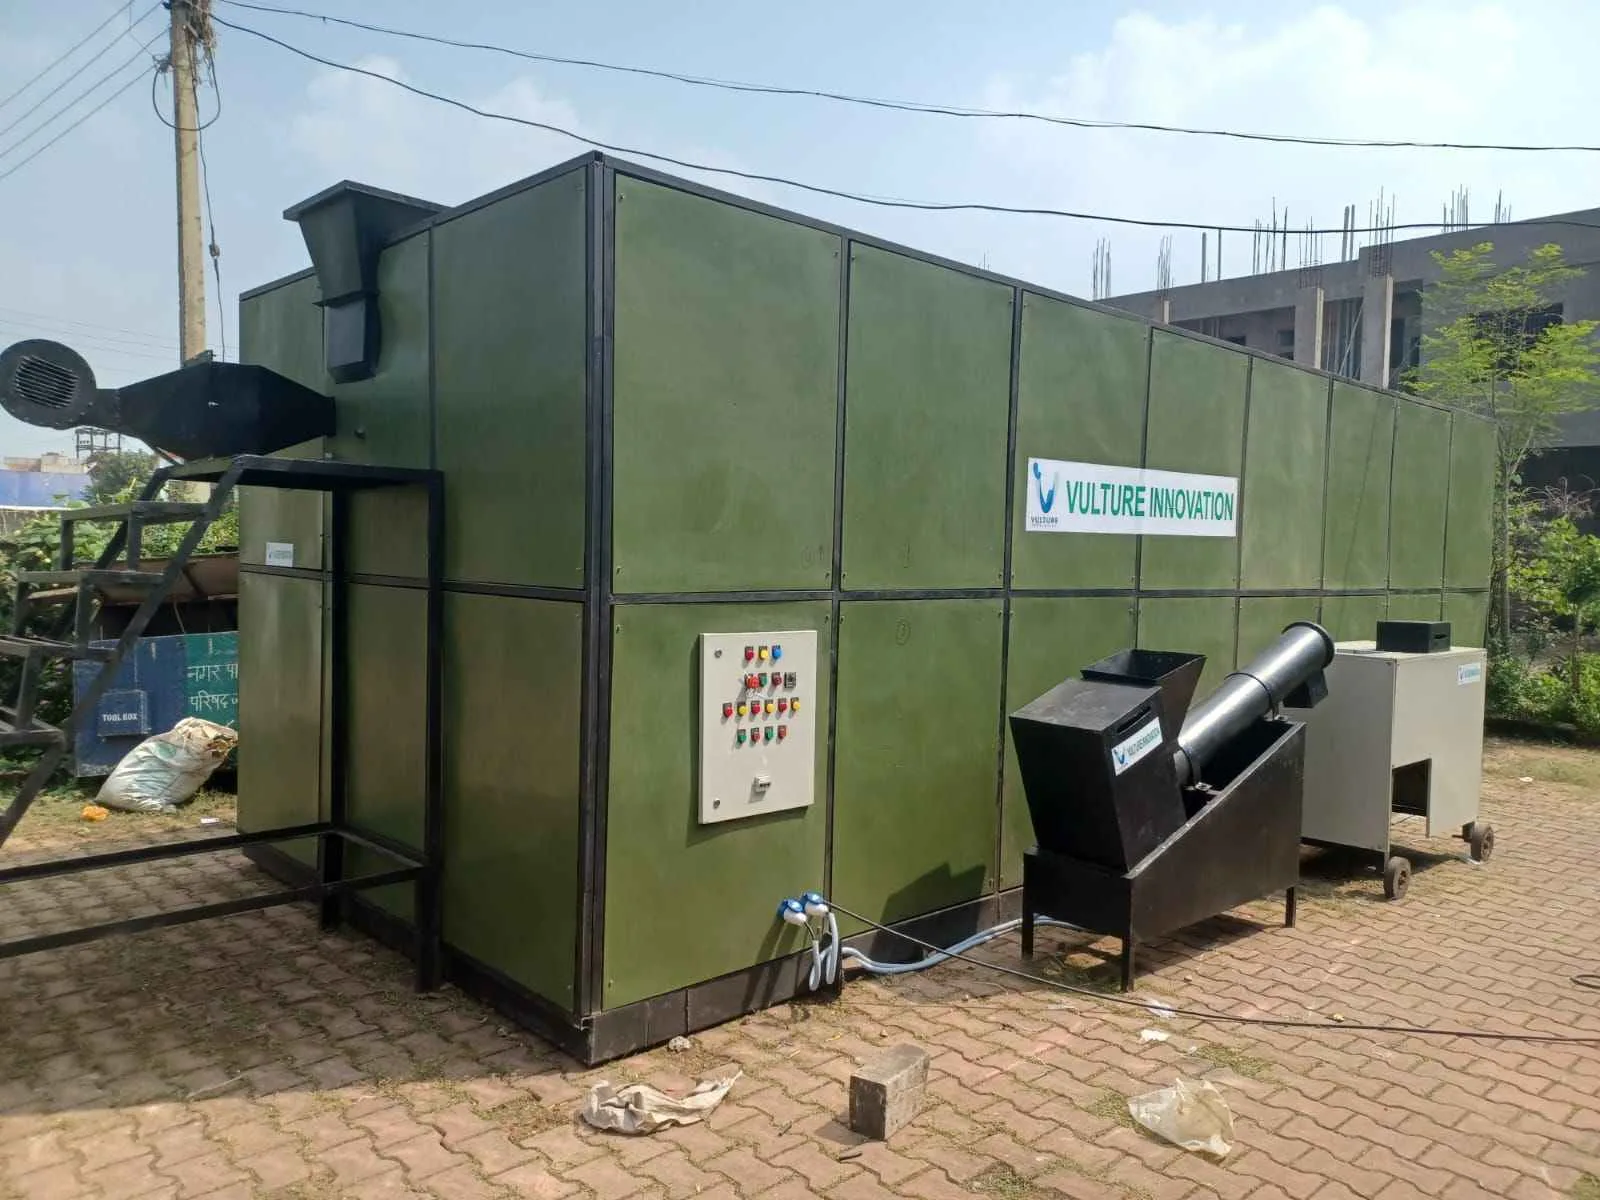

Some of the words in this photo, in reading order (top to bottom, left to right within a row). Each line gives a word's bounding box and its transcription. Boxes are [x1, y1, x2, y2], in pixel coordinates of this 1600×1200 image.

[1066, 481, 1146, 516] VULTURE
[1150, 487, 1233, 521] INNOVATION
[187, 665, 220, 681] नगर
[226, 663, 238, 680] पा
[102, 713, 121, 721] TOOL
[122, 712, 138, 721] BOX
